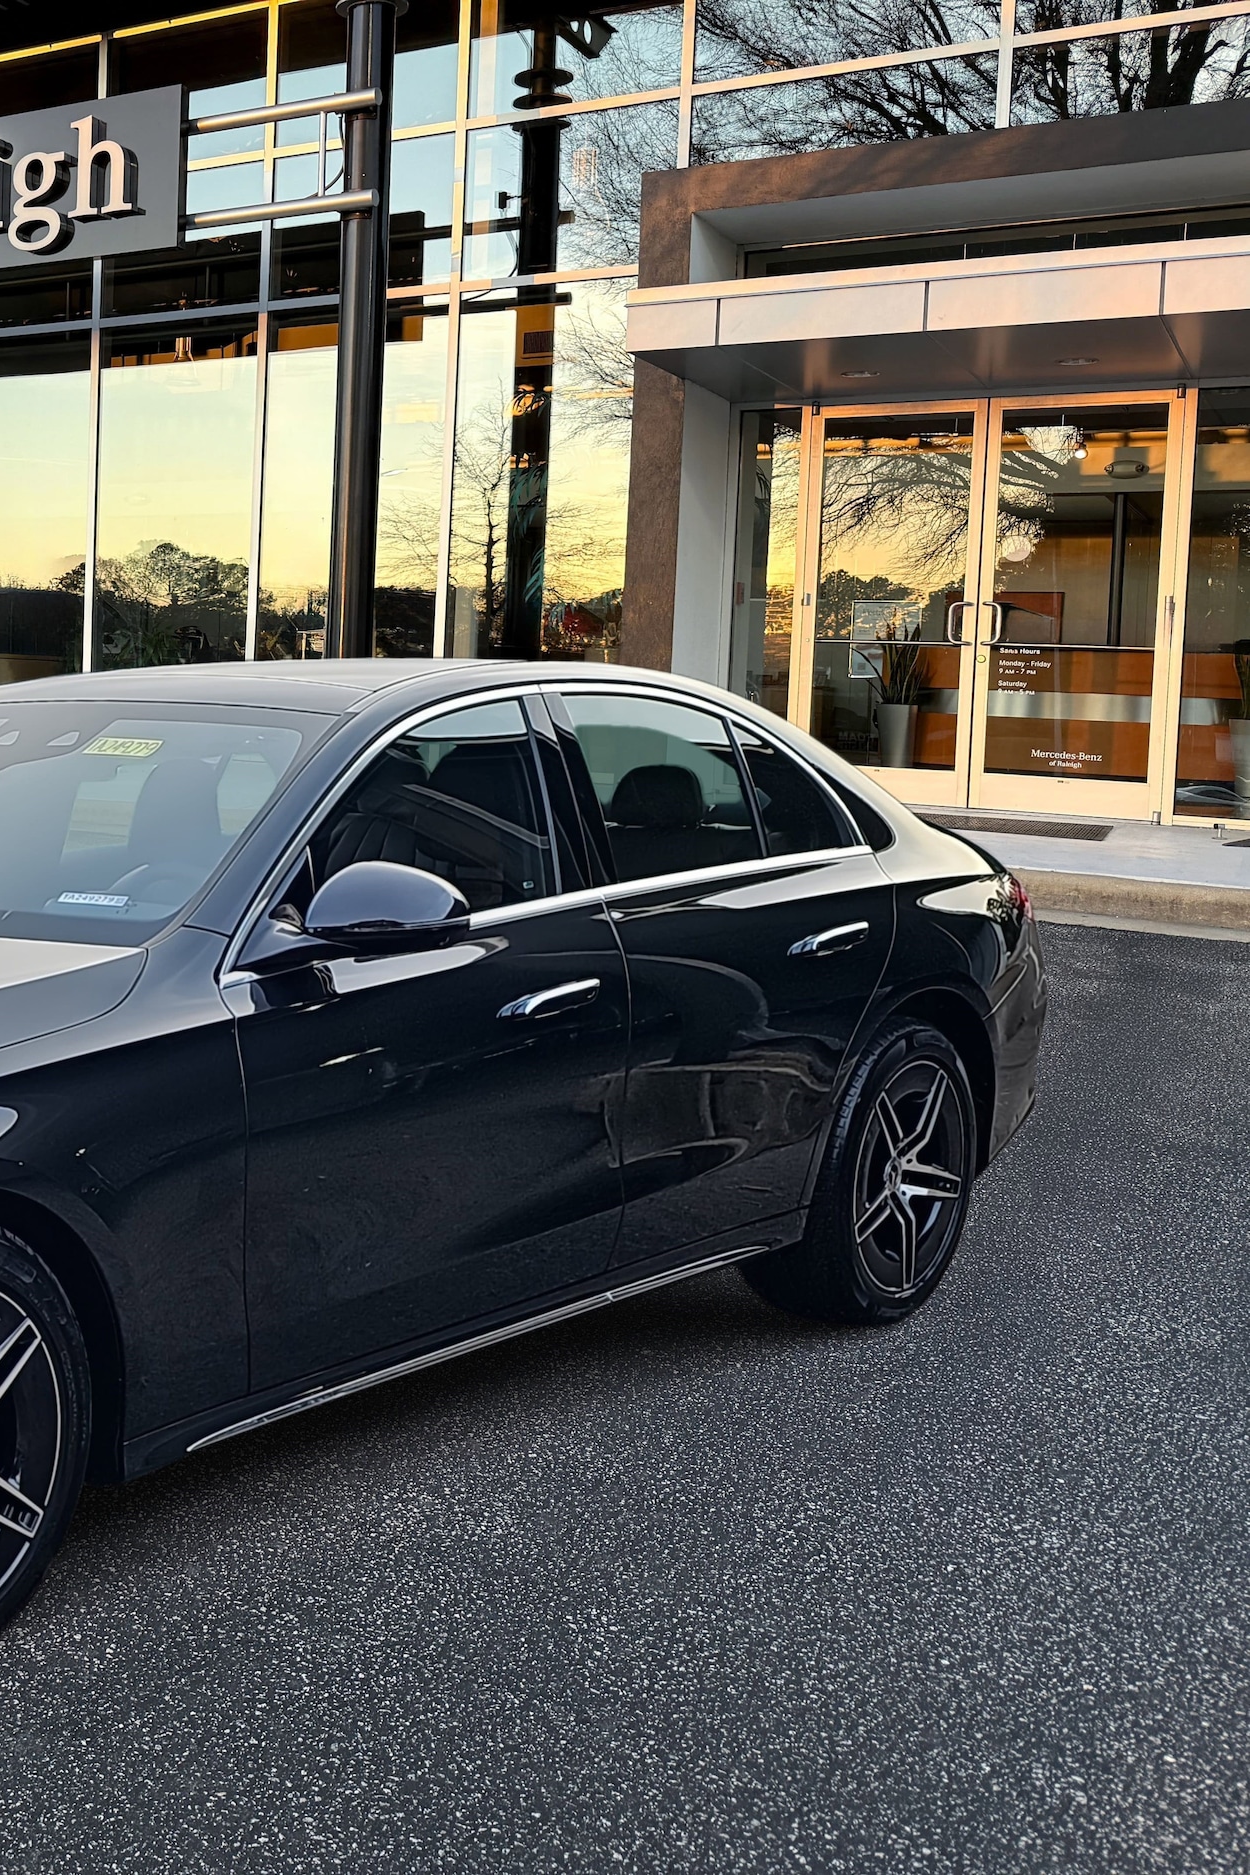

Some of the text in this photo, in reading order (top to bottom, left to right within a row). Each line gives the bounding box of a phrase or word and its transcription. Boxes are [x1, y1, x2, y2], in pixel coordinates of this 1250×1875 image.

[1031, 661, 1051, 669] Friday
[998, 680, 1027, 688] Saturday
[1031, 749, 1102, 762] Mercedes-Benz
[1057, 761, 1082, 769] Raleigh
